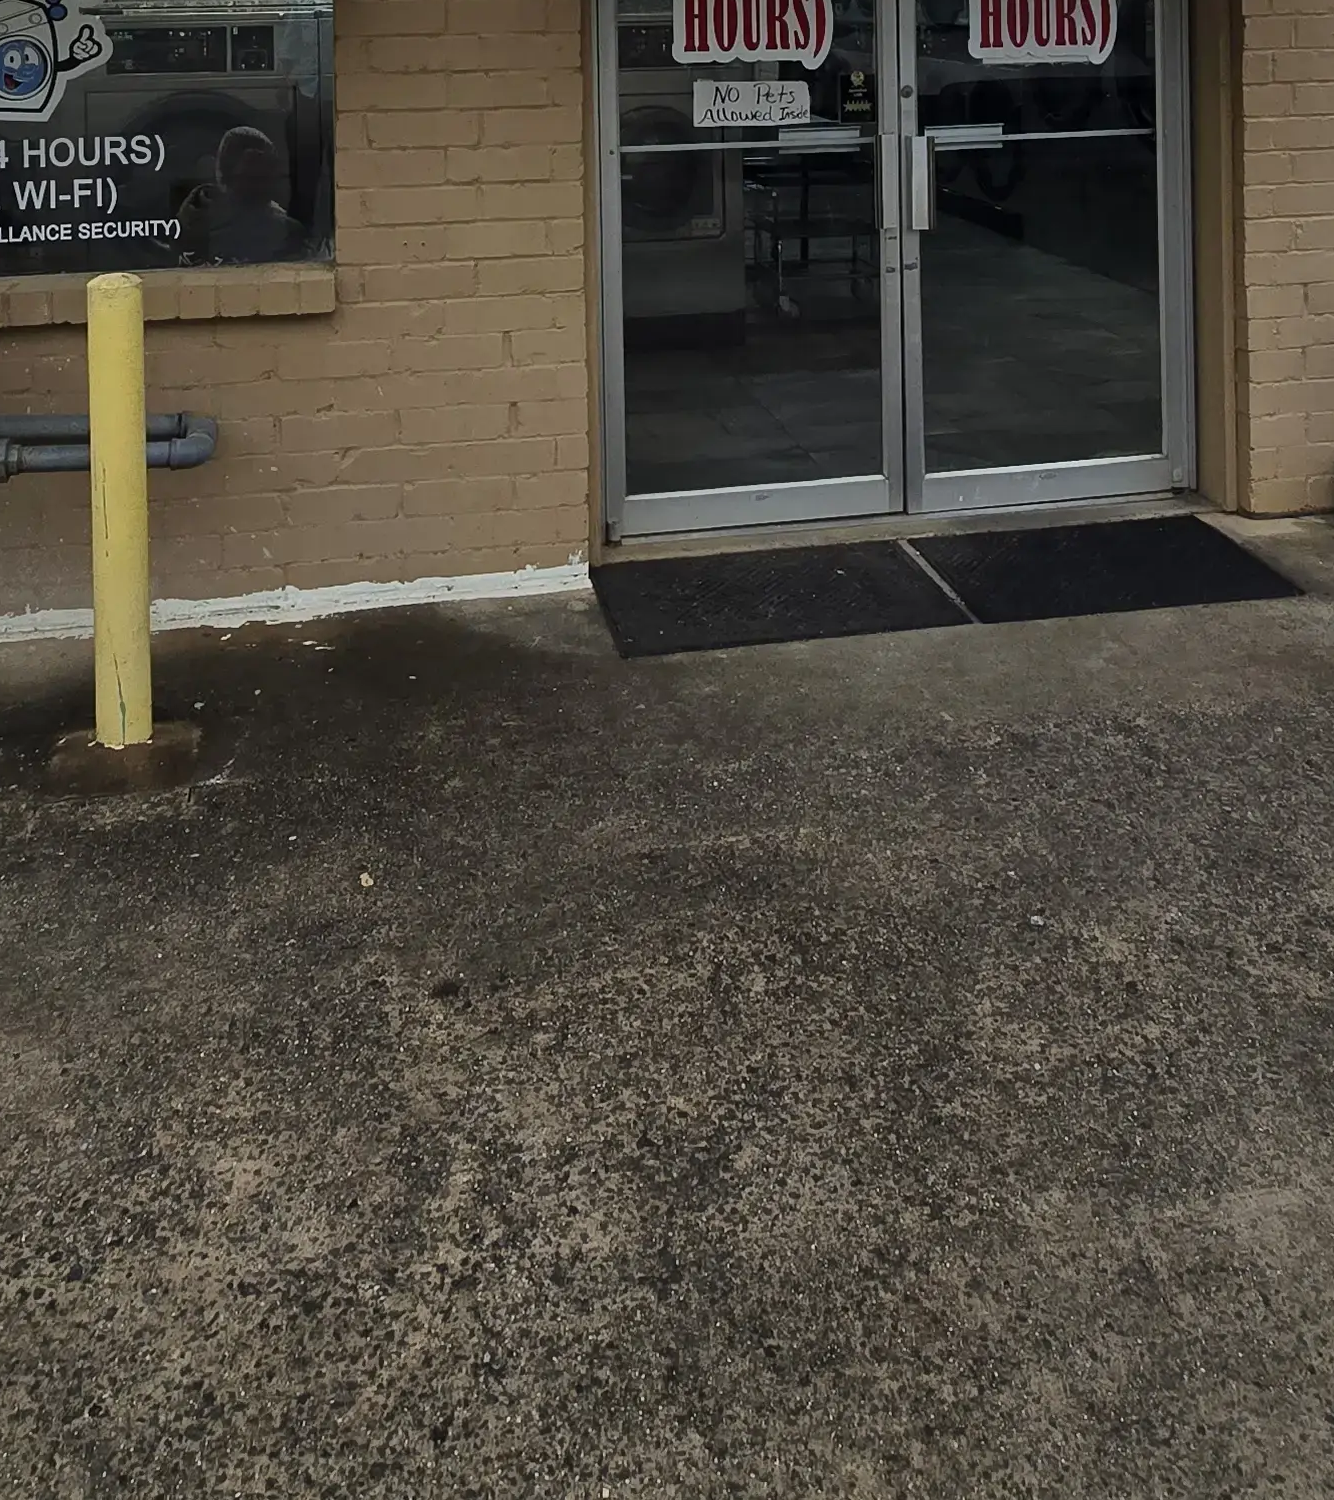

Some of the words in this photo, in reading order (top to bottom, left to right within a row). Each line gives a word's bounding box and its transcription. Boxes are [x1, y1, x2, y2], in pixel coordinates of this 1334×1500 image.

[712, 84, 740, 107] NO
[753, 82, 796, 105] Pets
[697, 105, 776, 125] Allowed
[778, 105, 810, 121] Inside
[23, 134, 166, 172] HOURS)
[12, 177, 118, 214] WI-FI)
[78, 218, 182, 240] SECURITY)
